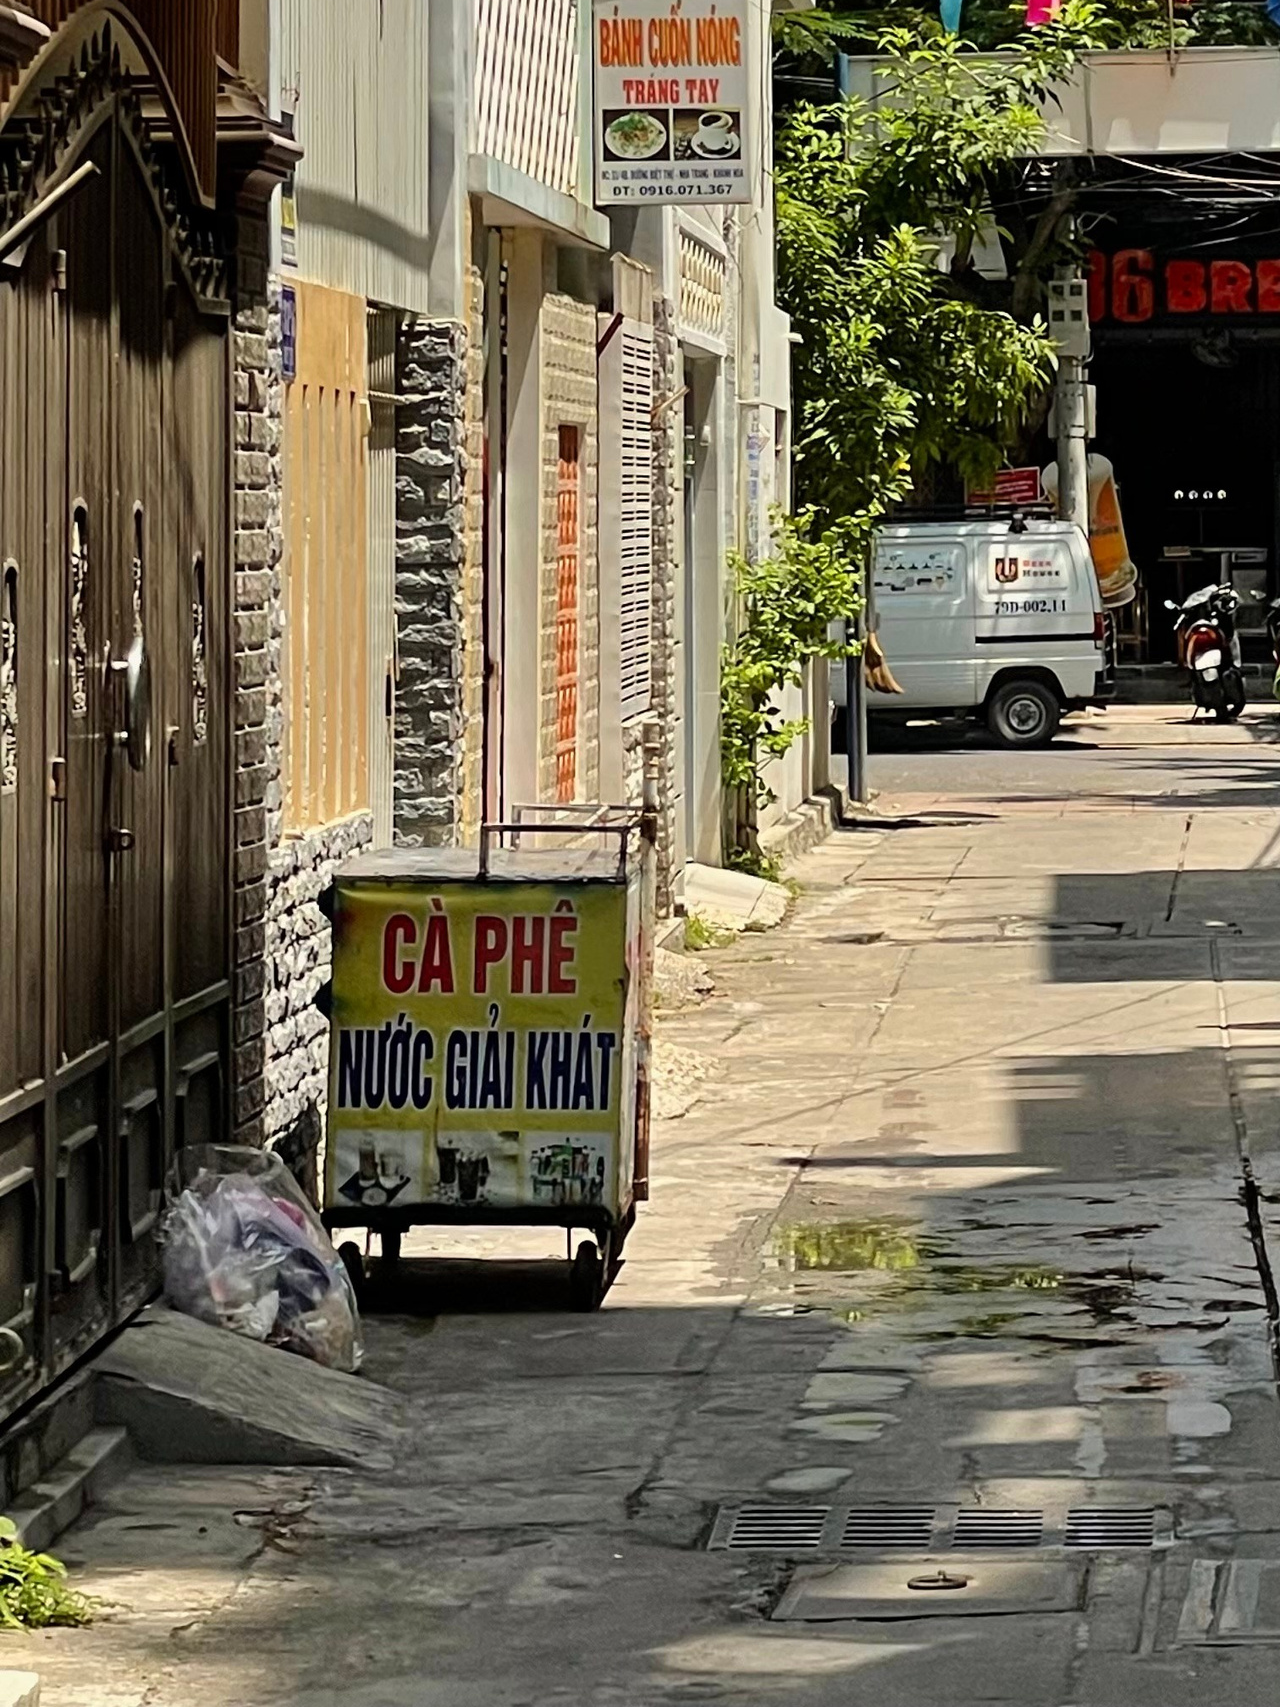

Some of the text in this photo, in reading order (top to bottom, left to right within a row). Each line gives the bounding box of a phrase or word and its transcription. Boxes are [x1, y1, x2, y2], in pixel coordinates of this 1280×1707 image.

[600, 0, 741, 67] BÁNH CUỐN NÓNG
[623, 73, 719, 104] TRÁNG TAY
[639, 184, 733, 196] 0916.071.367
[383, 898, 577, 994] CÀ PHÊ
[338, 1003, 616, 1110] NƯỚC GIẢI KHÁT
